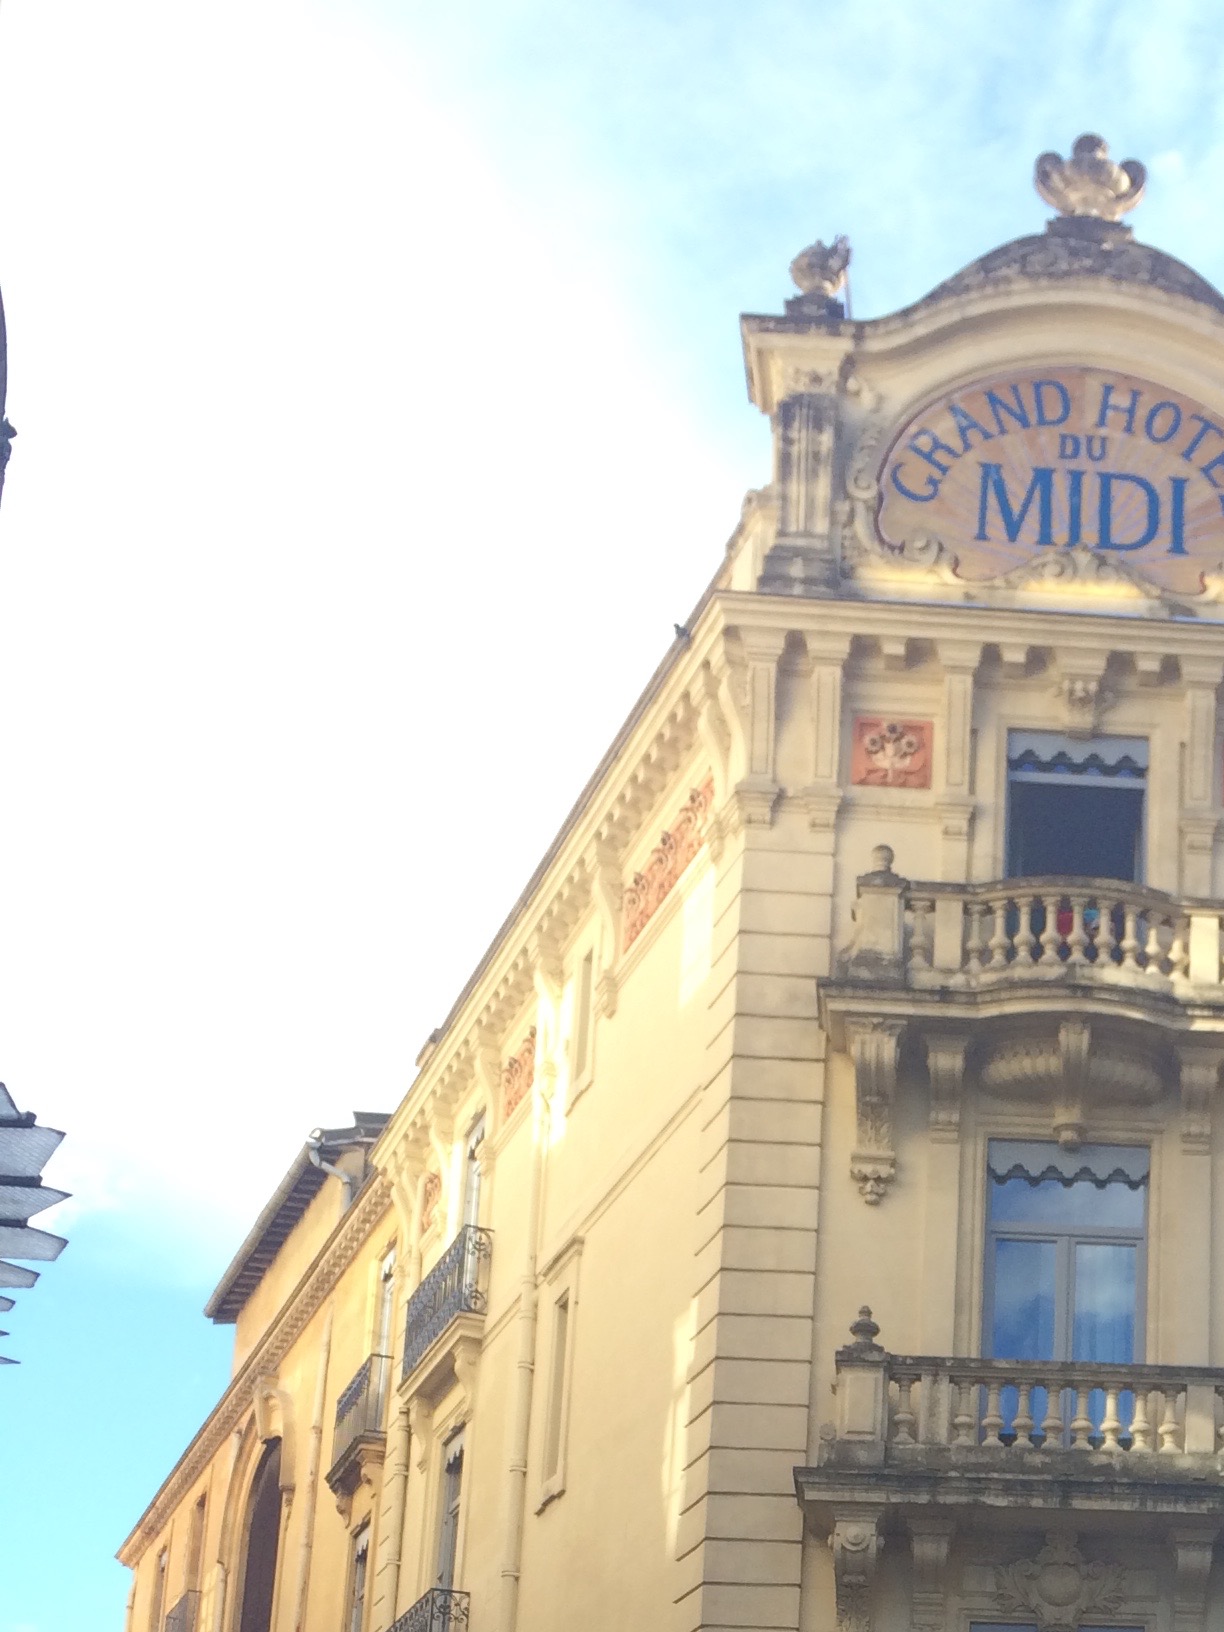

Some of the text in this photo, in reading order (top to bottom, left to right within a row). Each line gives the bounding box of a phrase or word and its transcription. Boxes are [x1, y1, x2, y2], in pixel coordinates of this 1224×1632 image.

[891, 379, 1071, 503] GRAND
[1058, 433, 1109, 461] DU
[974, 461, 1191, 555] MIDI
